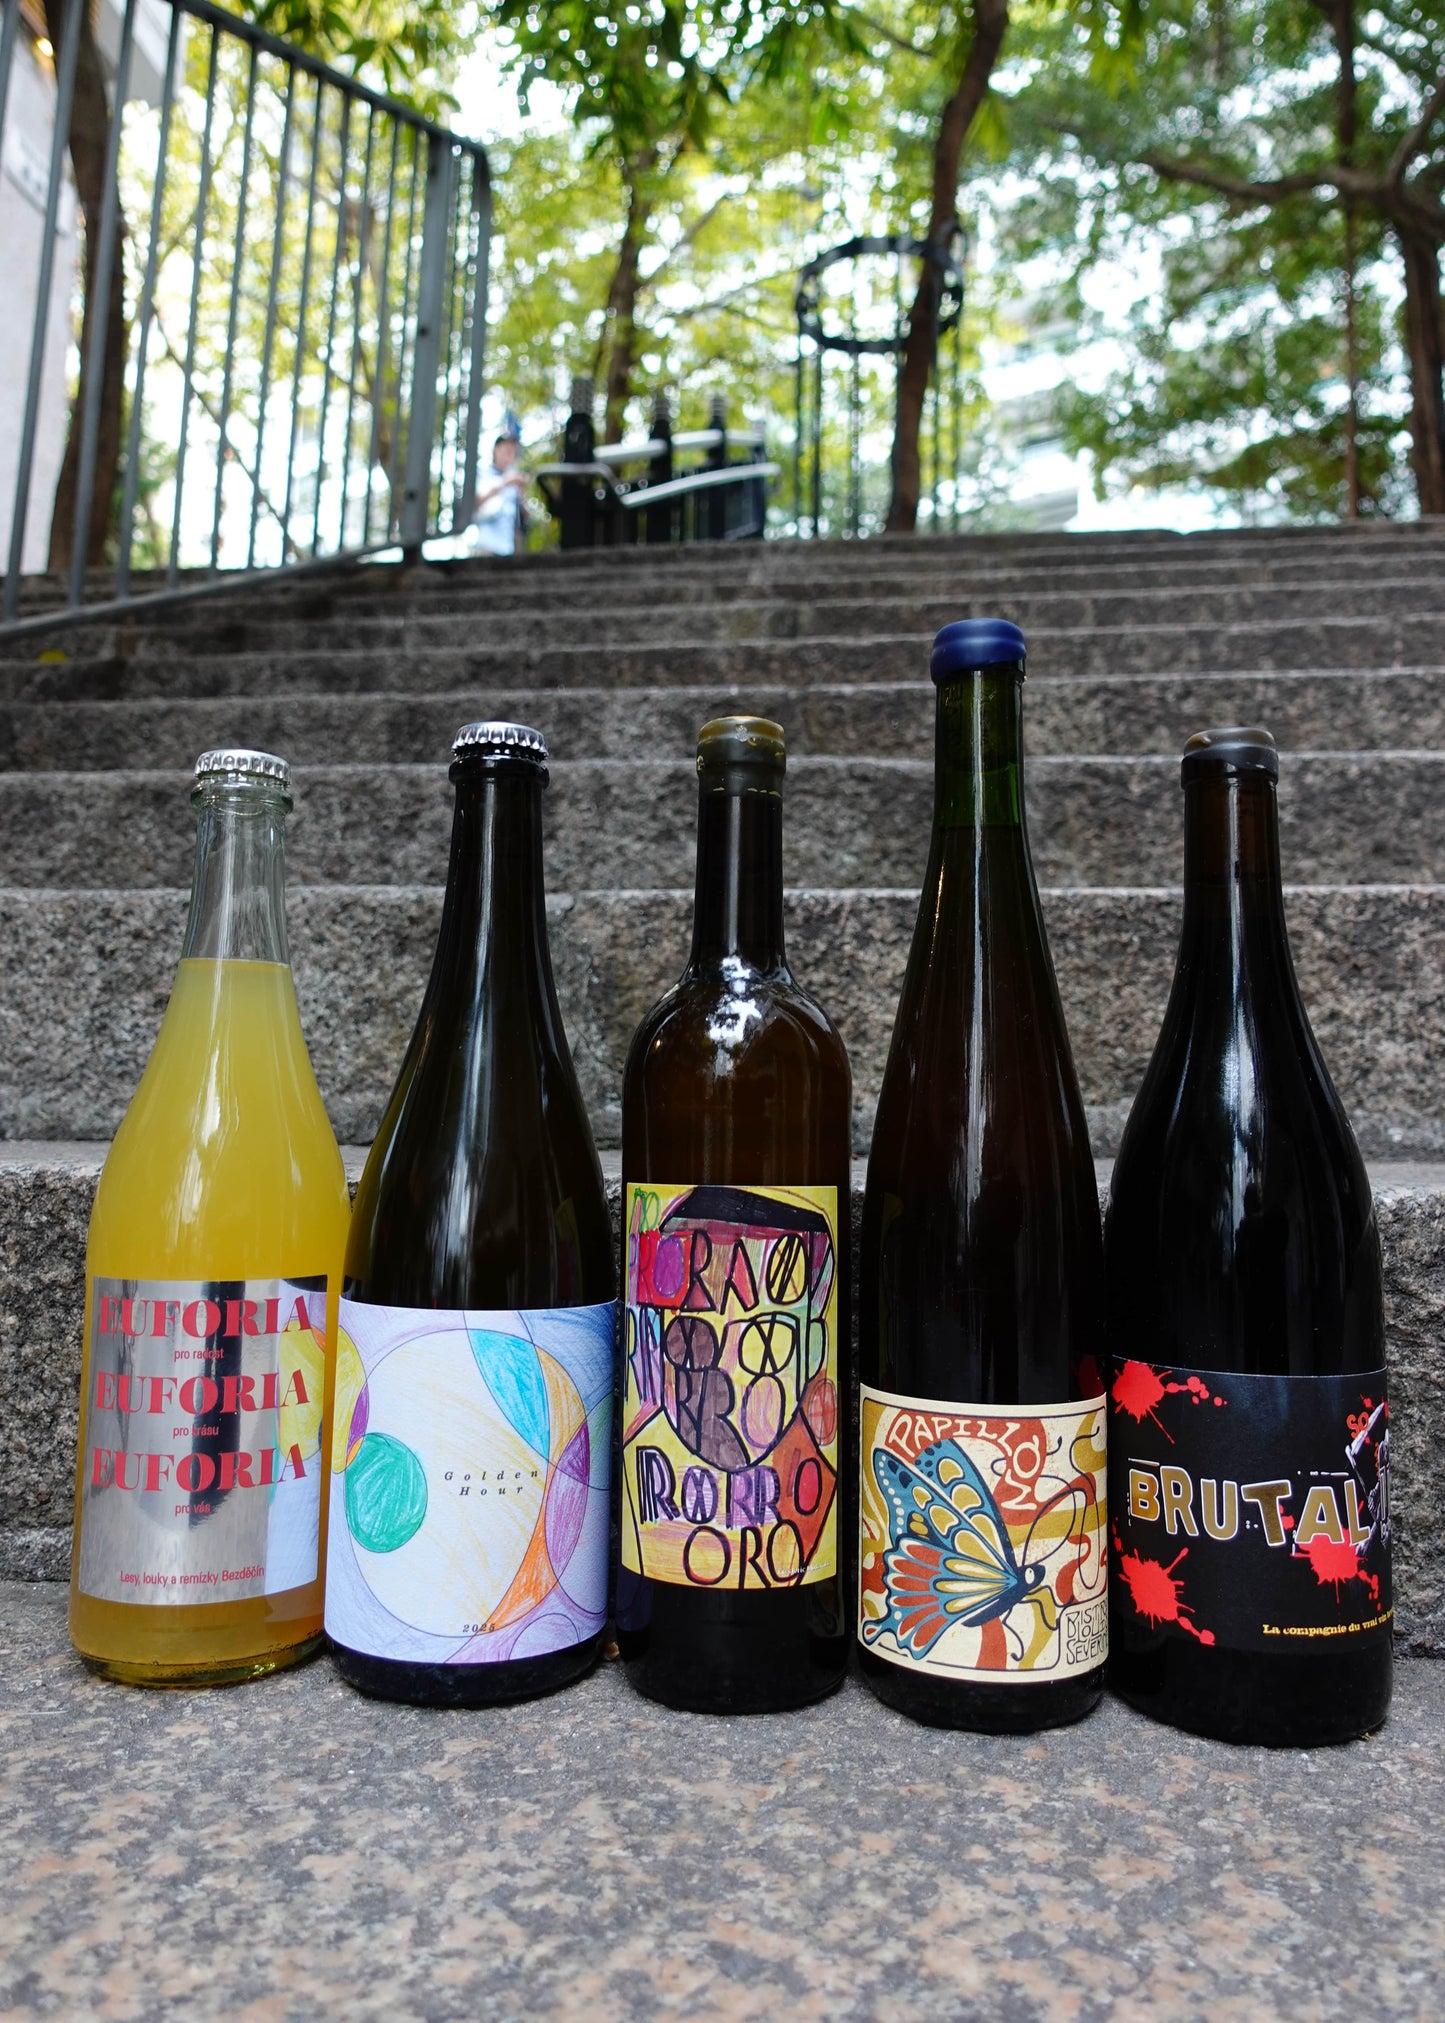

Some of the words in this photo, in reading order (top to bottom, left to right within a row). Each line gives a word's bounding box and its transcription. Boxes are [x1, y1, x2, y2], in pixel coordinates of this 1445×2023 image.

[99, 1295, 314, 1338] EUFORIA
[174, 1349, 190, 1363] pro
[193, 1347, 225, 1360] radost
[95, 1368, 310, 1415] EUFORIA
[173, 1426, 189, 1439] pro
[192, 1425, 220, 1437] krásu
[91, 1443, 308, 1493] EUFORIA
[888, 1414, 1041, 1511] PAPILLON
[444, 1470, 538, 1481] Golden
[460, 1486, 523, 1496] Hour
[175, 1504, 191, 1517] pro
[193, 1502, 211, 1514] vás
[1128, 1464, 1372, 1547] BRUTAL
[120, 1570, 141, 1587] Lesy,
[143, 1571, 168, 1588] louky
[171, 1576, 177, 1585] a
[179, 1570, 219, 1587] remízky
[222, 1564, 265, 1582] Bezděčín
[1262, 1624, 1280, 1635] La
[1283, 1624, 1347, 1637] compagnie
[1348, 1622, 1360, 1633] du
